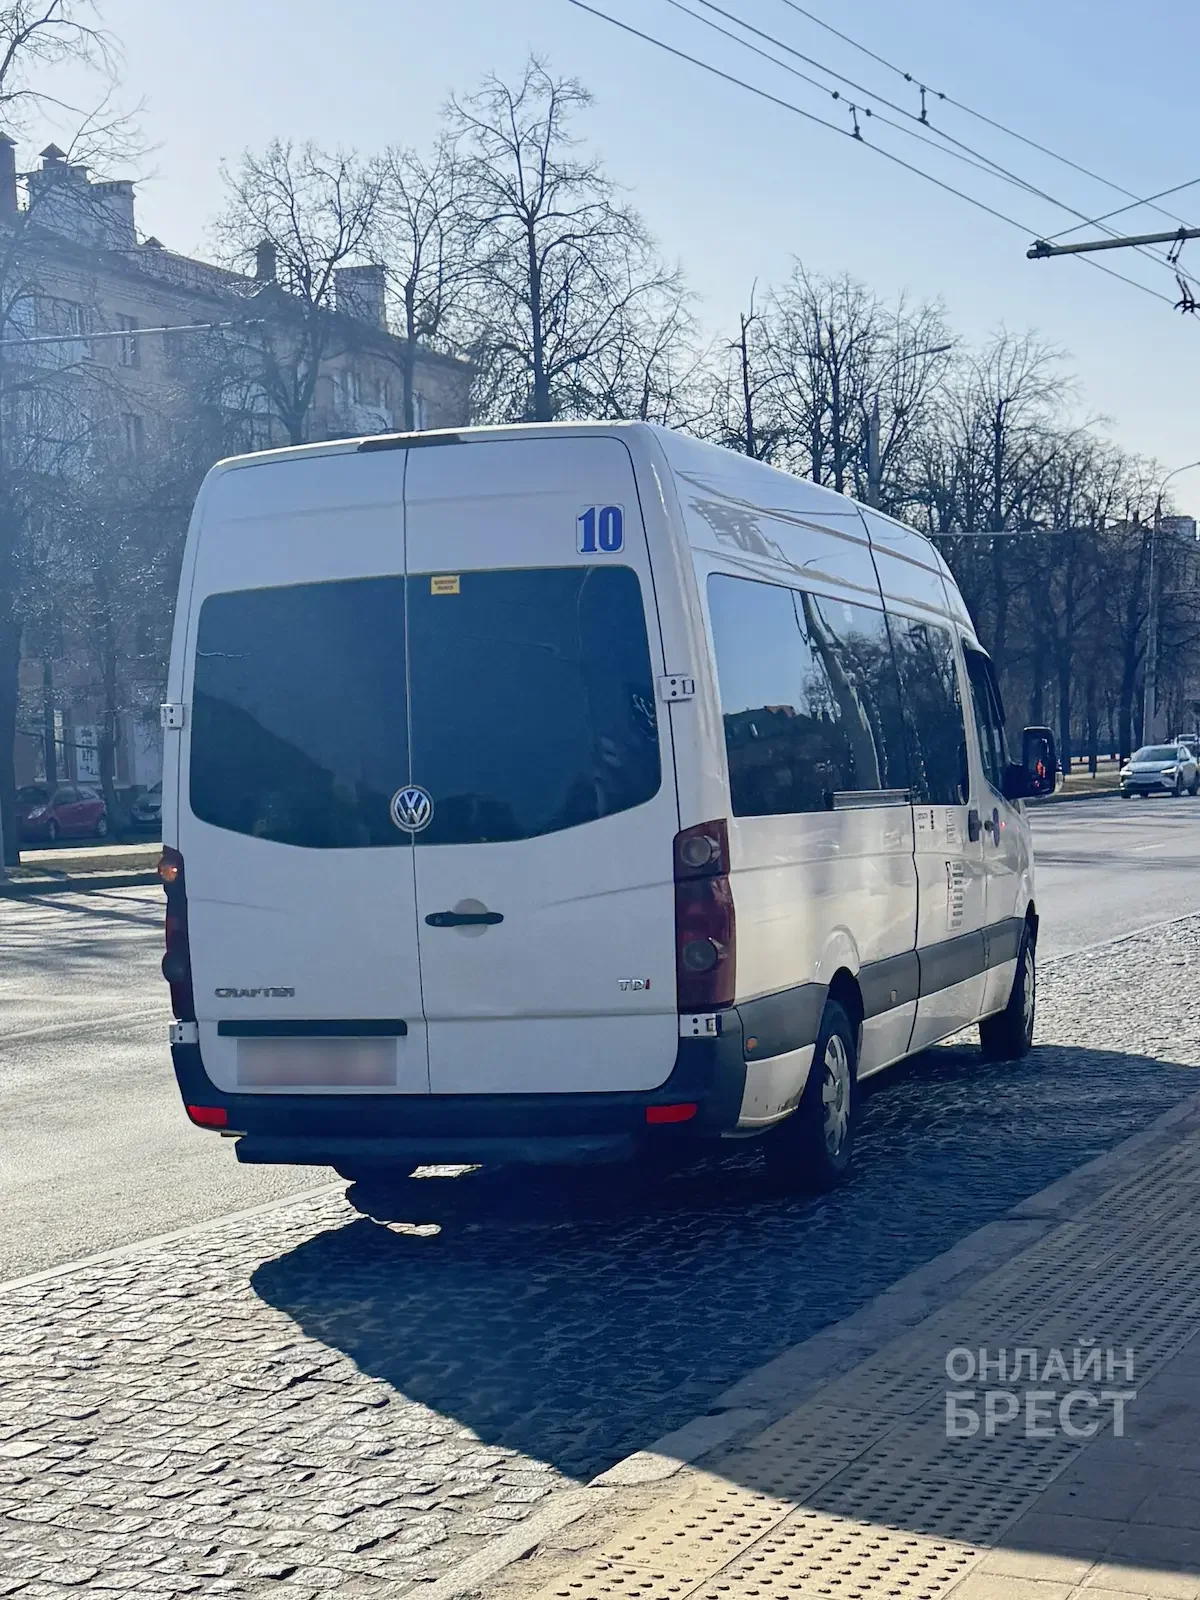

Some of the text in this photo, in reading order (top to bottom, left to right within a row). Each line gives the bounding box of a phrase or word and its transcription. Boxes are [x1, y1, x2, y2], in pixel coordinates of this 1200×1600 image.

[578, 506, 623, 552] 10
[618, 979, 651, 991] TDI
[214, 986, 295, 998] CRAFTER
